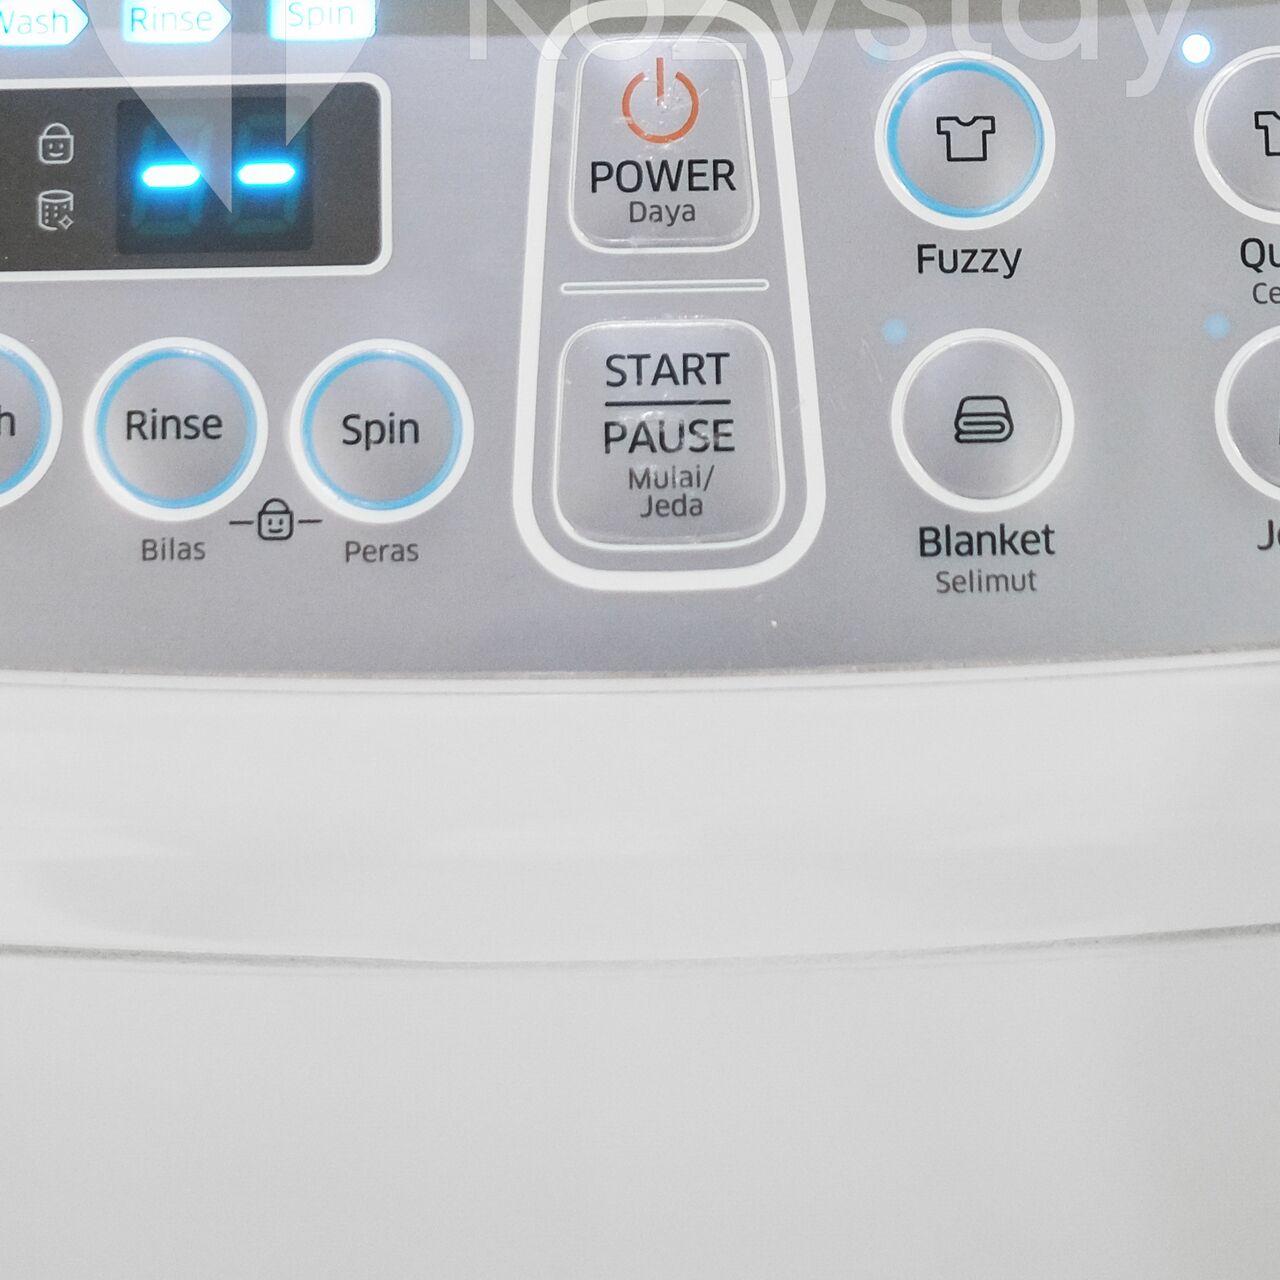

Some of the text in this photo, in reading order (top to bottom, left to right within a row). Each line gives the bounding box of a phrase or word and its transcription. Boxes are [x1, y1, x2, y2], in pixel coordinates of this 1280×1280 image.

[131, 6, 213, 33] Rinse
[287, 1, 354, 32] Spin
[590, 158, 737, 194] POWER
[629, 200, 696, 227] Daya
[916, 243, 1022, 279] Fuzzy
[605, 352, 730, 387] START
[126, 408, 223, 441] Rinse
[341, 413, 420, 451] Spin
[604, 418, 735, 454] PAUSE
[628, 464, 715, 491] Mulai/
[640, 494, 703, 518] Jeda
[141, 537, 206, 562] Bilas
[345, 539, 419, 564] Peras
[918, 522, 1056, 558] Blanket
[935, 568, 1037, 593] Selimut
